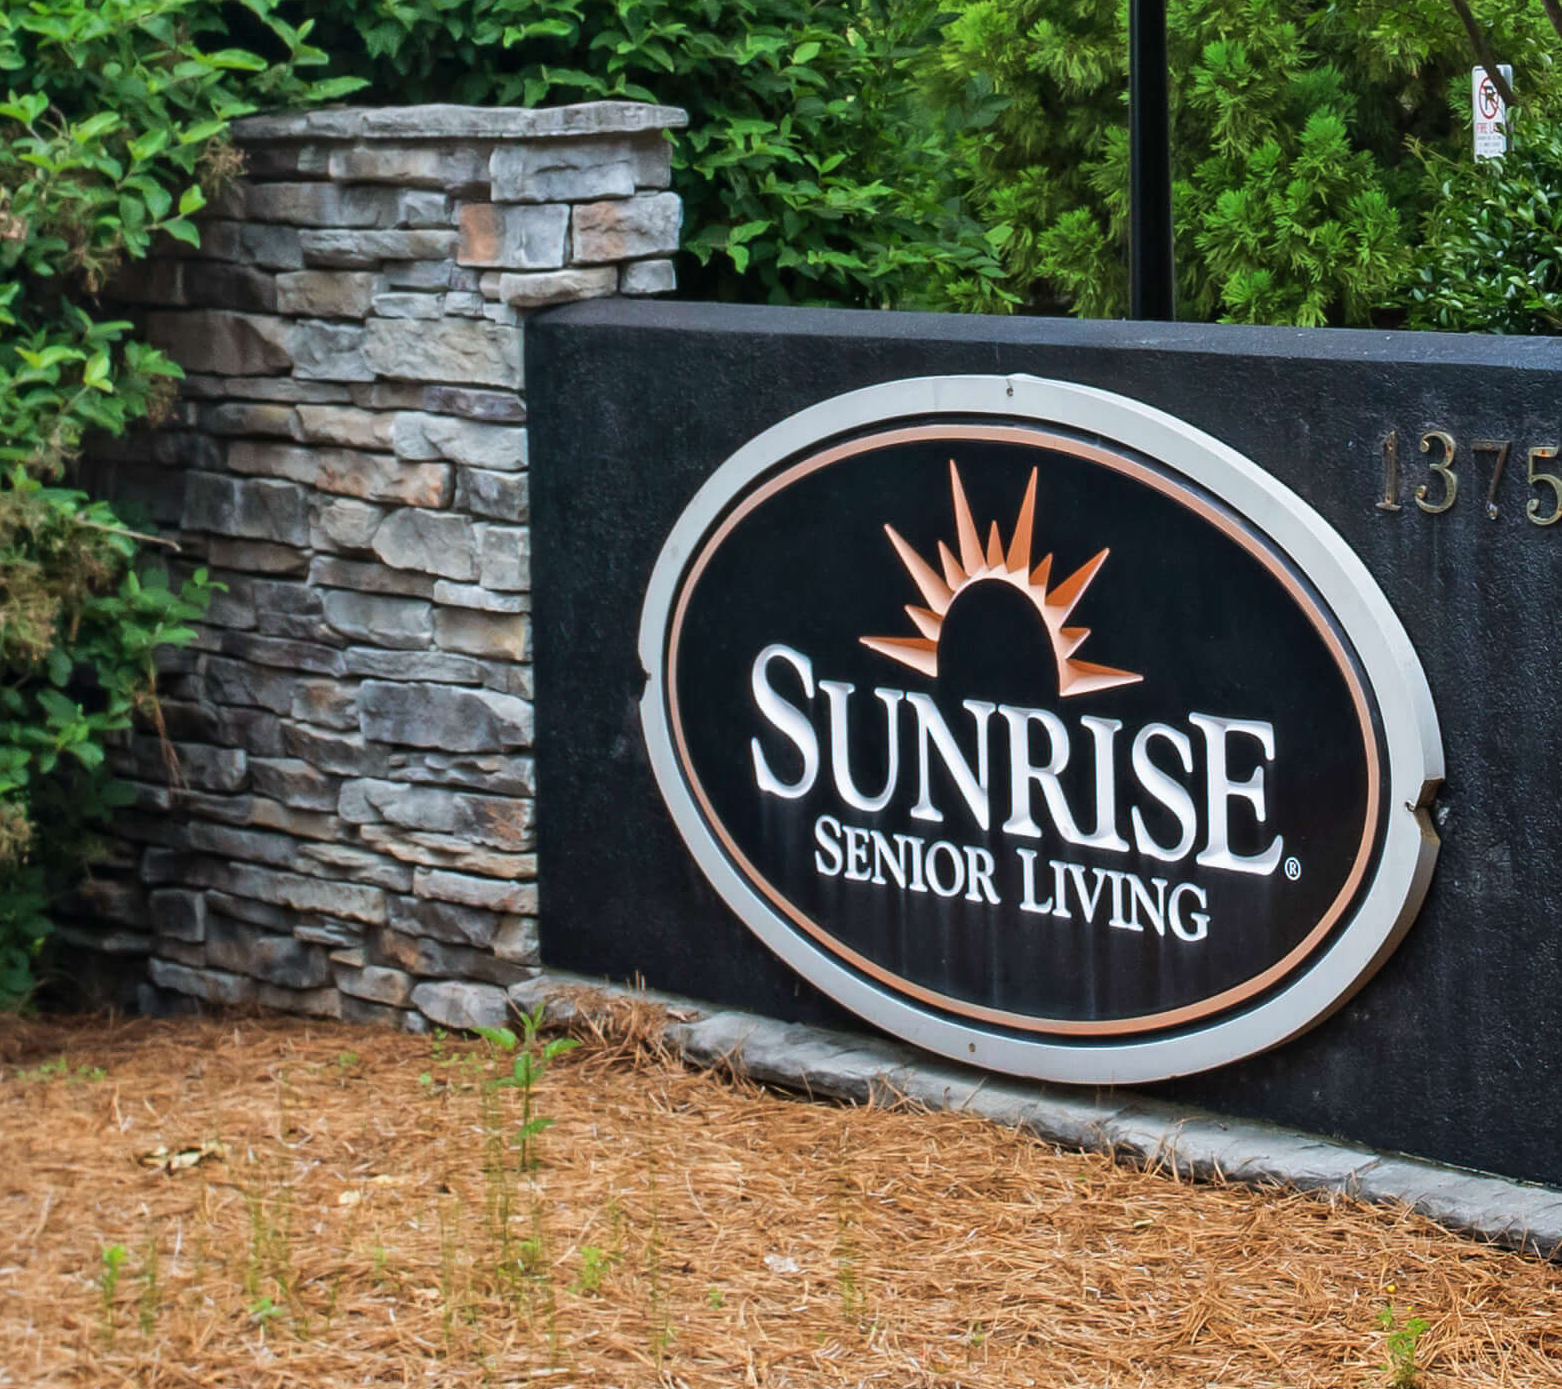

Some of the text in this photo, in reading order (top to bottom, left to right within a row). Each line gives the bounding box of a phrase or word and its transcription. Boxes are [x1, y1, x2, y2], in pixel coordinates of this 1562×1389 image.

[751, 643, 1284, 876] SUNRISE
[814, 814, 1211, 942] SENIOR LIVING
